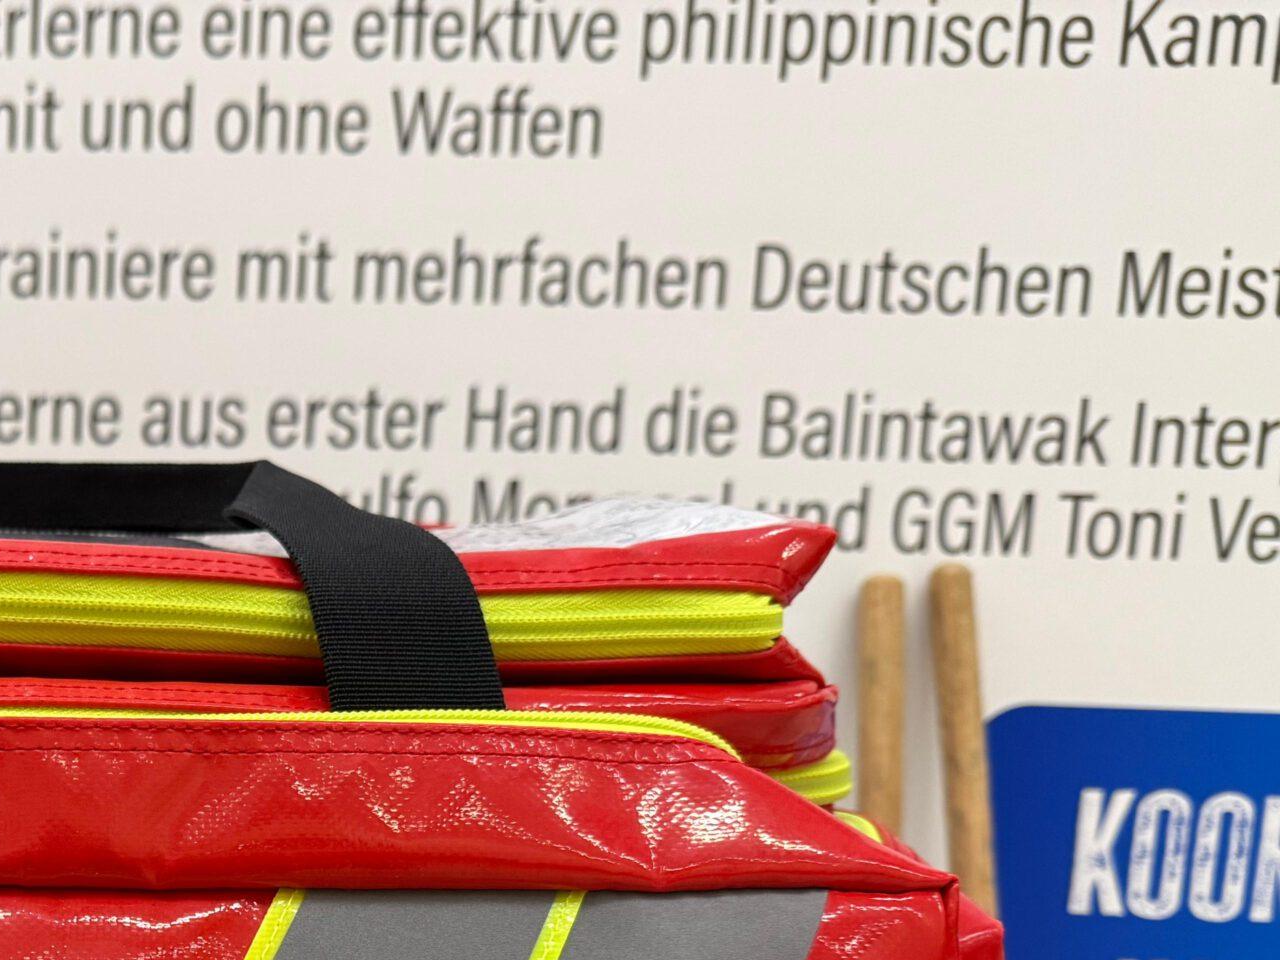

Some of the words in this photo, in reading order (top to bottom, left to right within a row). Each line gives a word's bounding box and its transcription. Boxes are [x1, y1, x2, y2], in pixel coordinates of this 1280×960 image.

[202, 0, 331, 60] eine
[353, 0, 618, 64] effektive
[640, 0, 1094, 83] philippinische
[80, 83, 195, 155] und
[219, 84, 370, 156] ohne
[392, 84, 604, 159] Waffen
[236, 232, 336, 303] mit
[353, 235, 729, 311] mehrfachen
[751, 243, 1093, 317] Deutschen
[140, 393, 247, 449] aus
[266, 386, 445, 452] erster
[464, 385, 622, 456] Hand
[644, 387, 738, 457] die
[758, 391, 1111, 467] Balintawak
[1129, 398, 1280, 486] Inter
[891, 490, 1035, 559] GGM
[1058, 490, 1186, 562] Toni
